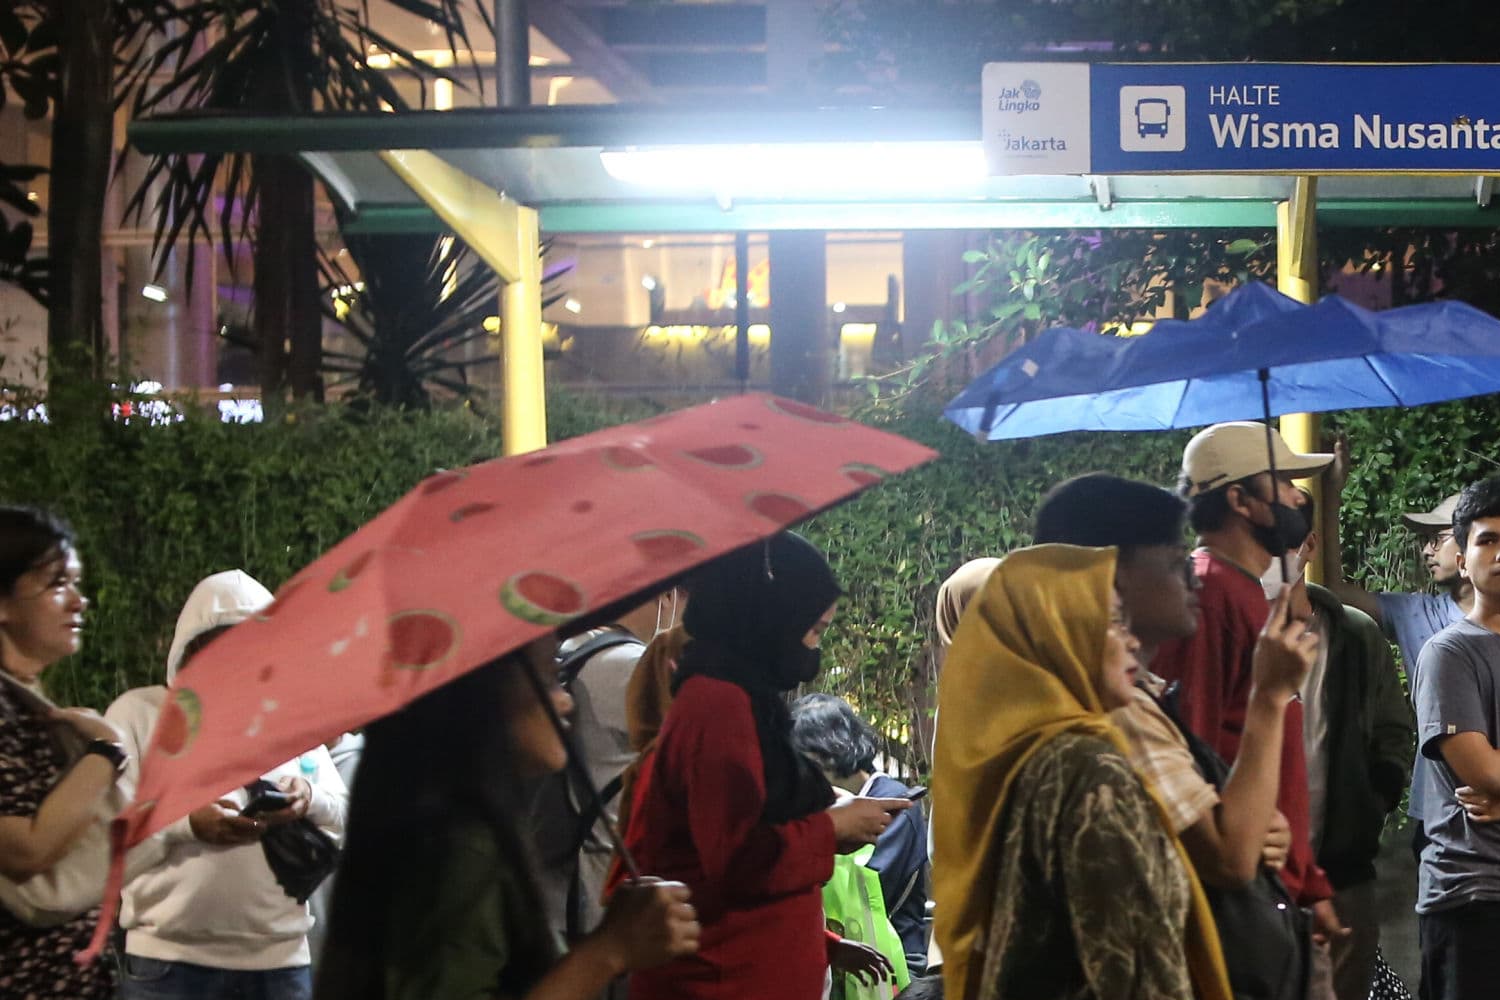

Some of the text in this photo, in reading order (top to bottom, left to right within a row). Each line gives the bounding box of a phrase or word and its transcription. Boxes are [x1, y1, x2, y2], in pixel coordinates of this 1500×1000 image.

[999, 88, 1020, 99] Jak
[1208, 85, 1281, 106] HALTE
[998, 100, 1040, 114] Lingko
[1208, 113, 1340, 149] Wisma
[1005, 136, 1067, 151] Jakarta
